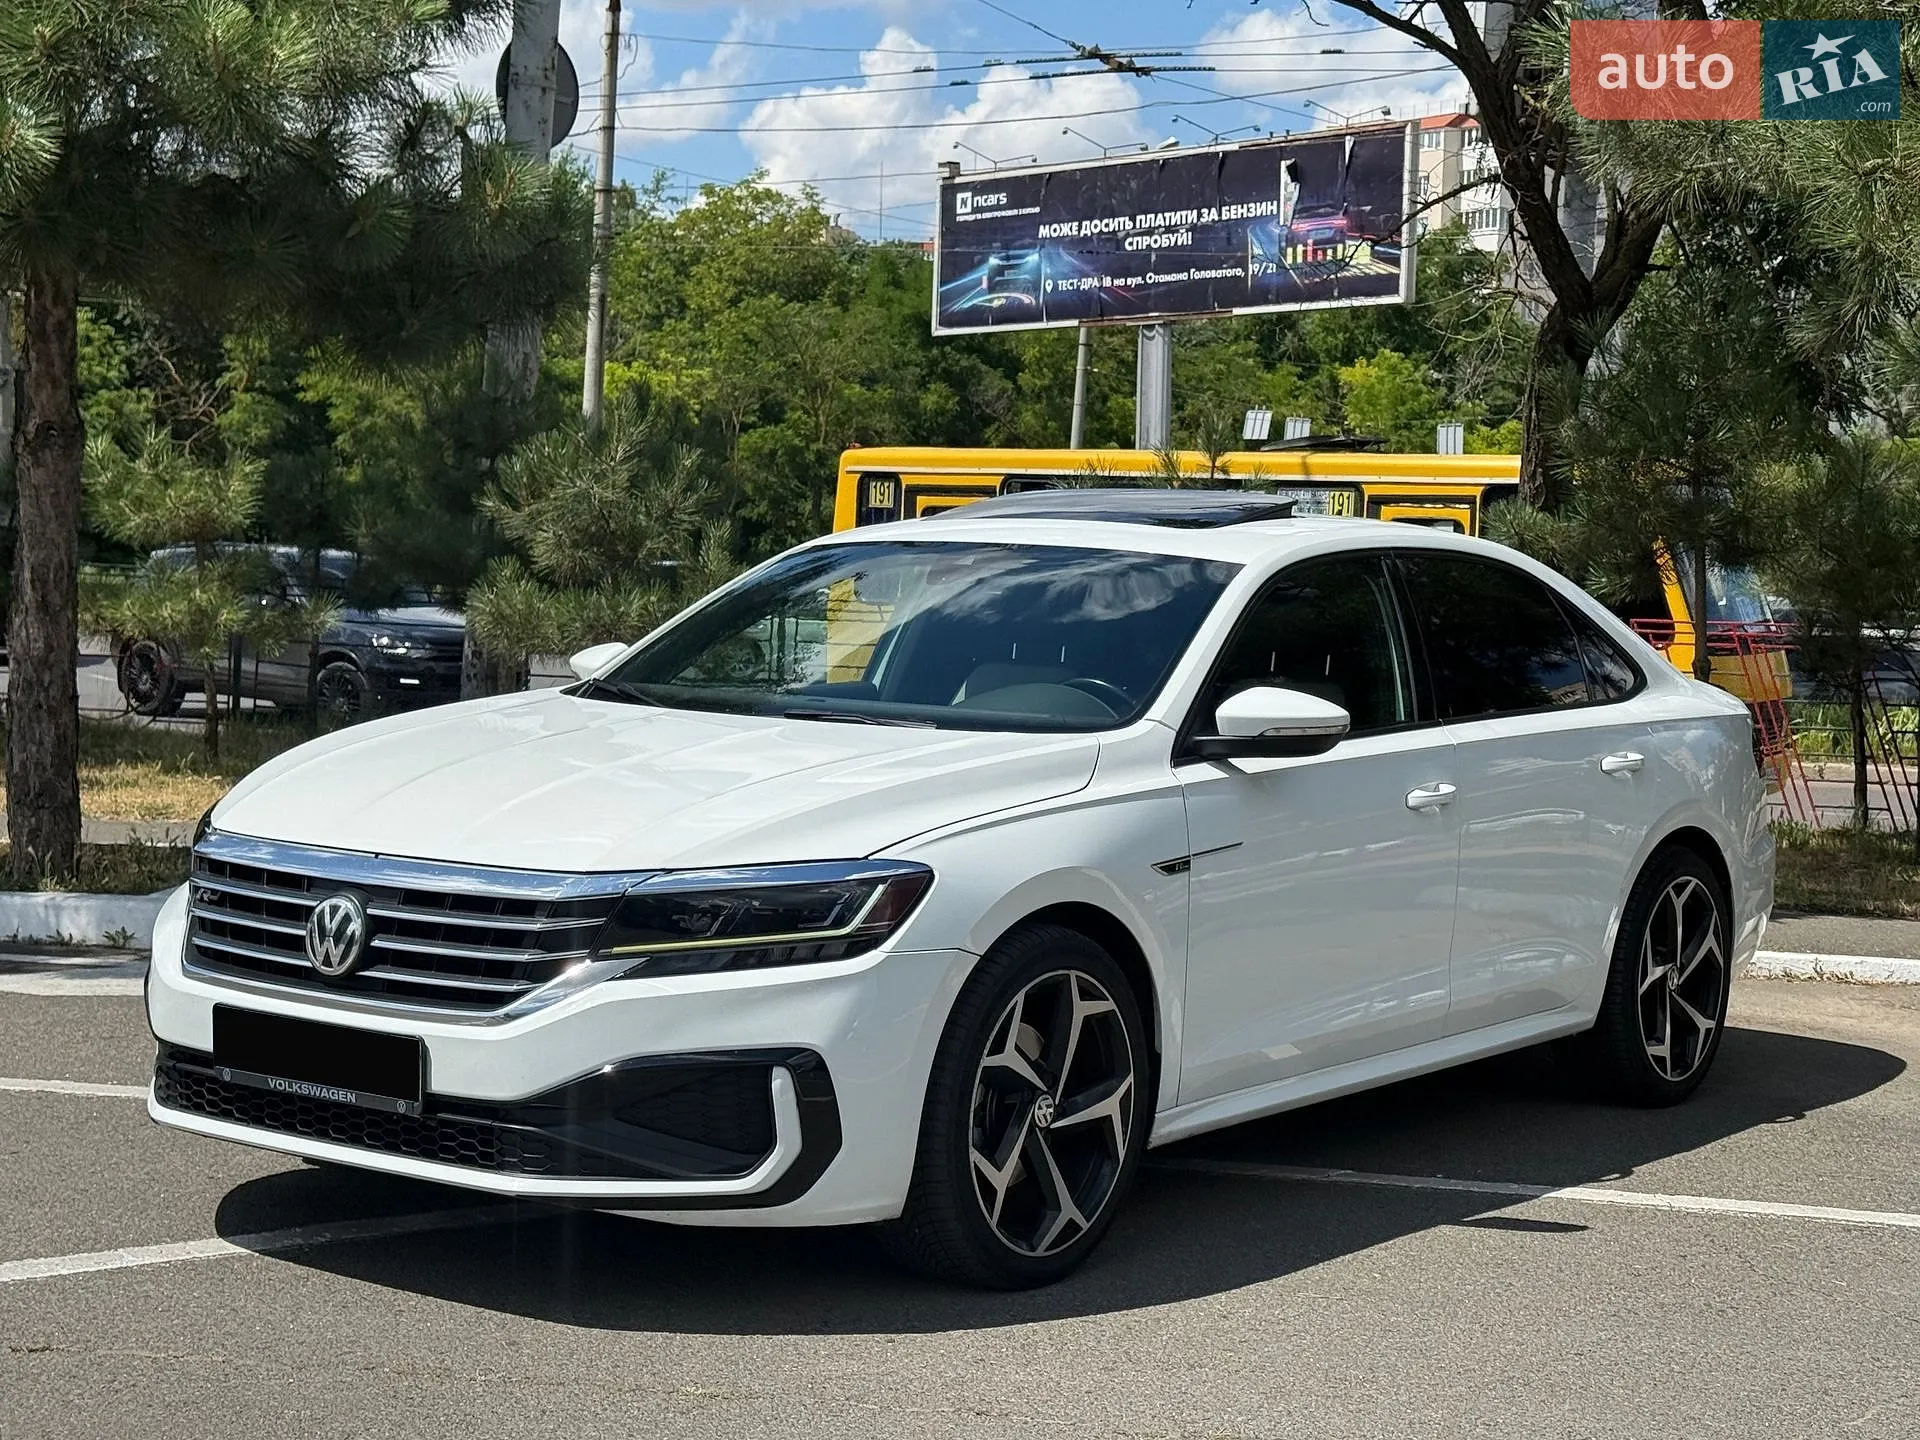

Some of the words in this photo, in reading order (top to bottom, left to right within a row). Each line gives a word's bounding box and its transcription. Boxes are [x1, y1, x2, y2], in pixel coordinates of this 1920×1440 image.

[973, 192, 1007, 208] ncars
[1038, 221, 1079, 239] МОЖЕ
[1080, 218, 1133, 237] ДОСИТЬ
[1135, 209, 1198, 231] ПЛАТИТИ
[1200, 208, 1219, 222] ЗА
[1221, 200, 1278, 220] БЕНЗИН
[1124, 231, 1192, 251] СПРОБУЙ!
[1113, 278, 1125, 287] на
[1126, 276, 1144, 288] вул.
[1146, 272, 1188, 284] Отамана
[1190, 267, 1245, 280] Головатого,
[1249, 263, 1277, 277] 19/21
[872, 481, 892, 505] 191
[1331, 492, 1351, 515] 191
[267, 1077, 356, 1103] VOLKSWAGEN
